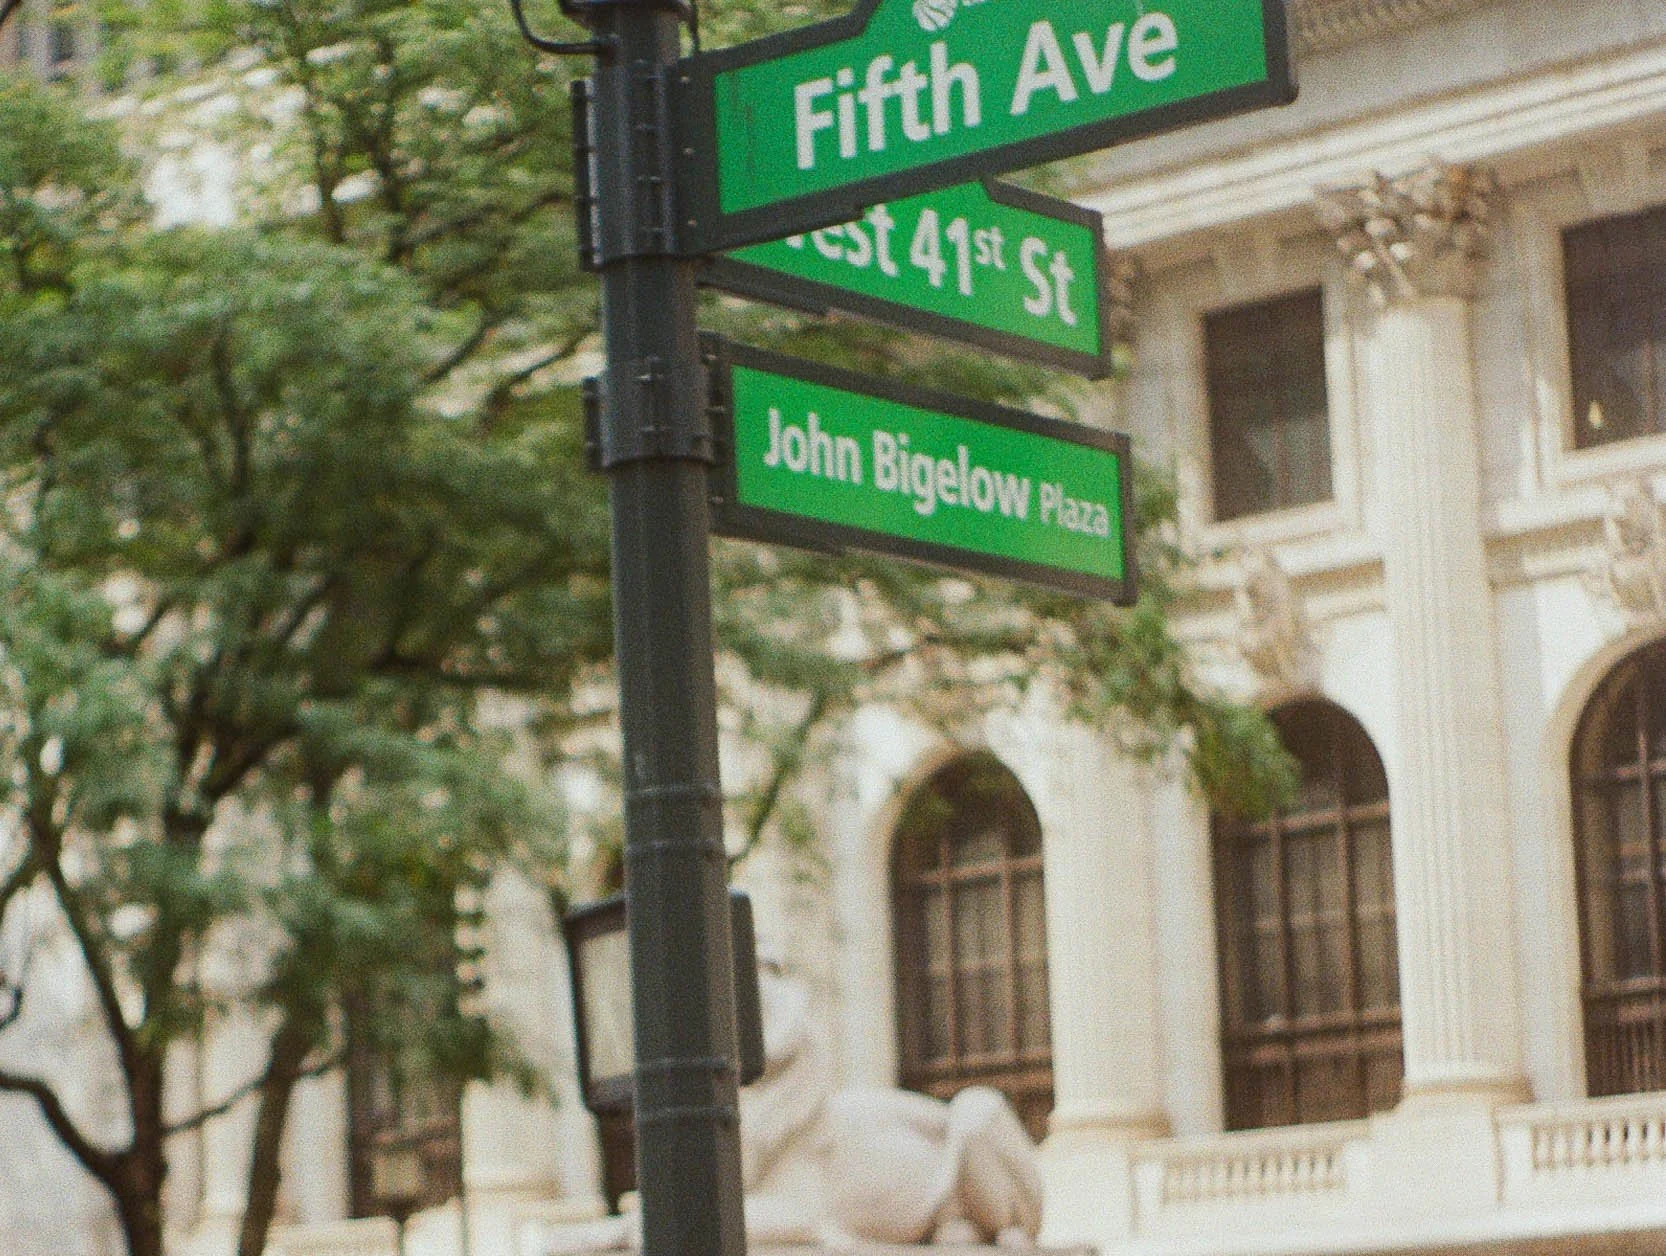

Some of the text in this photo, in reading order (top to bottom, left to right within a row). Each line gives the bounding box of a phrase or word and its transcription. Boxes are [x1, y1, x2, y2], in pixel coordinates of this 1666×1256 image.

[794, 12, 1179, 170] Fifth Ave
[786, 203, 1077, 327] est 41st St
[763, 407, 1111, 538] John Bigelow Plaza
